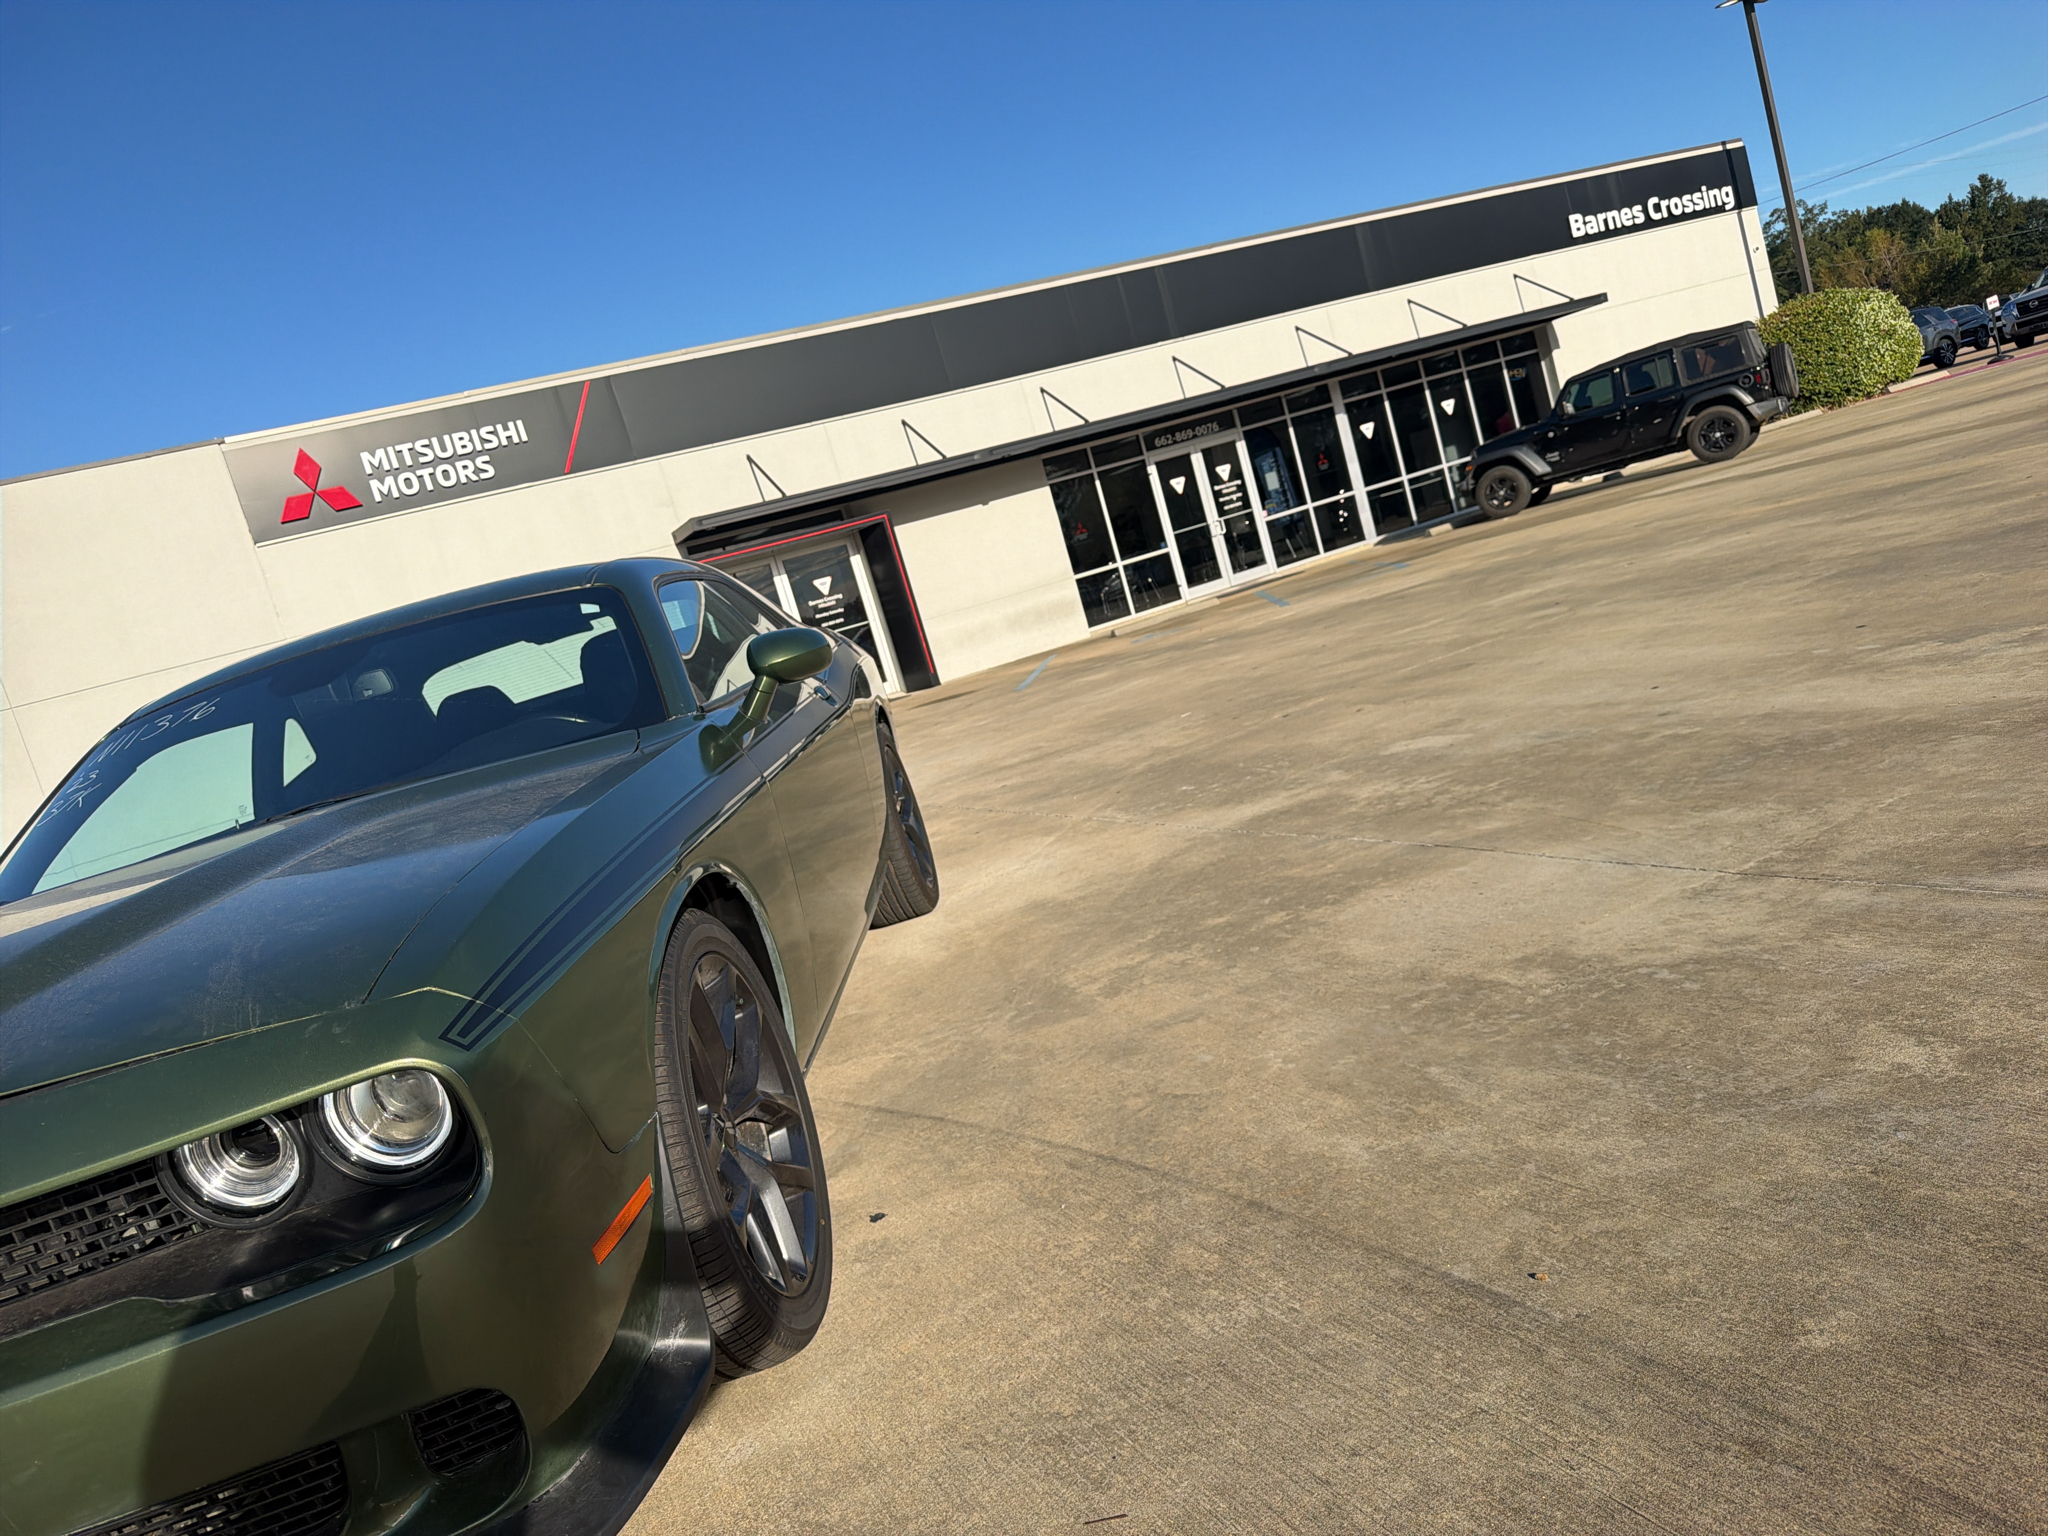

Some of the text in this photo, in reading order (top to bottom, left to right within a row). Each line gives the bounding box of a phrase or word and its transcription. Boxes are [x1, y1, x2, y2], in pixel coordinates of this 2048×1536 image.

[1568, 185, 1735, 238] Barnes Crossing
[361, 419, 528, 475] MITSUBISHI
[1154, 421, 1219, 447] 662-869-0076
[369, 455, 495, 502] MOTORS
